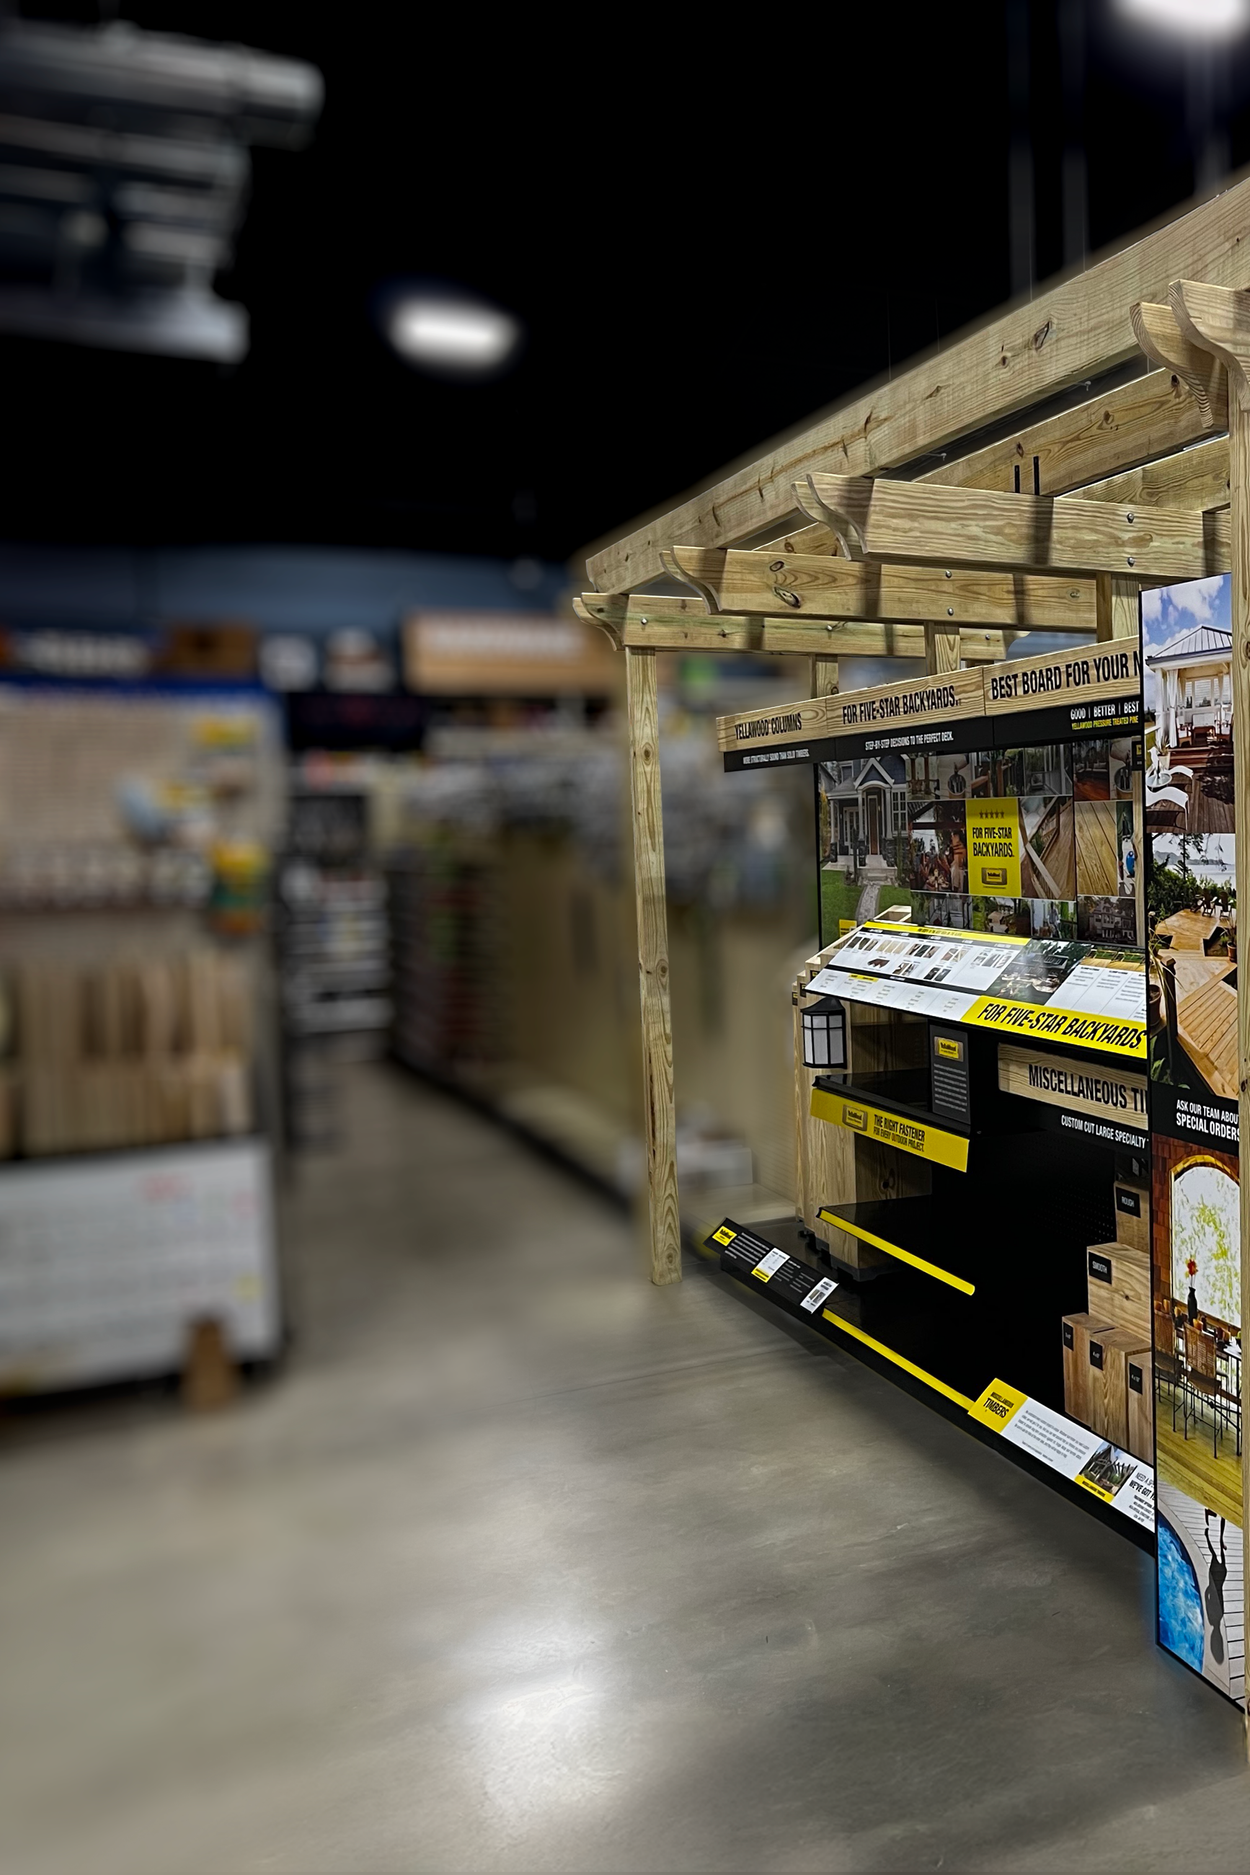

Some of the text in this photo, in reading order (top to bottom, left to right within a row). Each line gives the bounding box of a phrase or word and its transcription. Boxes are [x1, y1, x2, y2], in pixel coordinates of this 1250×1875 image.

[991, 673, 1019, 700] BEST
[1022, 665, 1062, 695] BOARD
[1065, 660, 1090, 688] FOR
[1093, 652, 1129, 683] YOUR
[842, 704, 858, 724] FOR
[859, 696, 901, 722] FIVE-STAR
[1070, 700, 1139, 720] GOOD BETTER BEST
[972, 826, 1013, 839] FOR FIVE-STAR
[977, 1002, 1008, 1022] FOR
[1000, 1006, 1067, 1034] FIVE-STAR
[1028, 1064, 1148, 1114] MISCELLANEOUS TI
[1176, 1099, 1239, 1125] ASK OUR TEAM ABOU
[1176, 1111, 1209, 1134] SPECIAL
[874, 1113, 884, 1128] THE
[899, 1123, 926, 1142] FASTENER
[1061, 1114, 1147, 1149] CUSTOM CUT LARGE SPECIALTY
